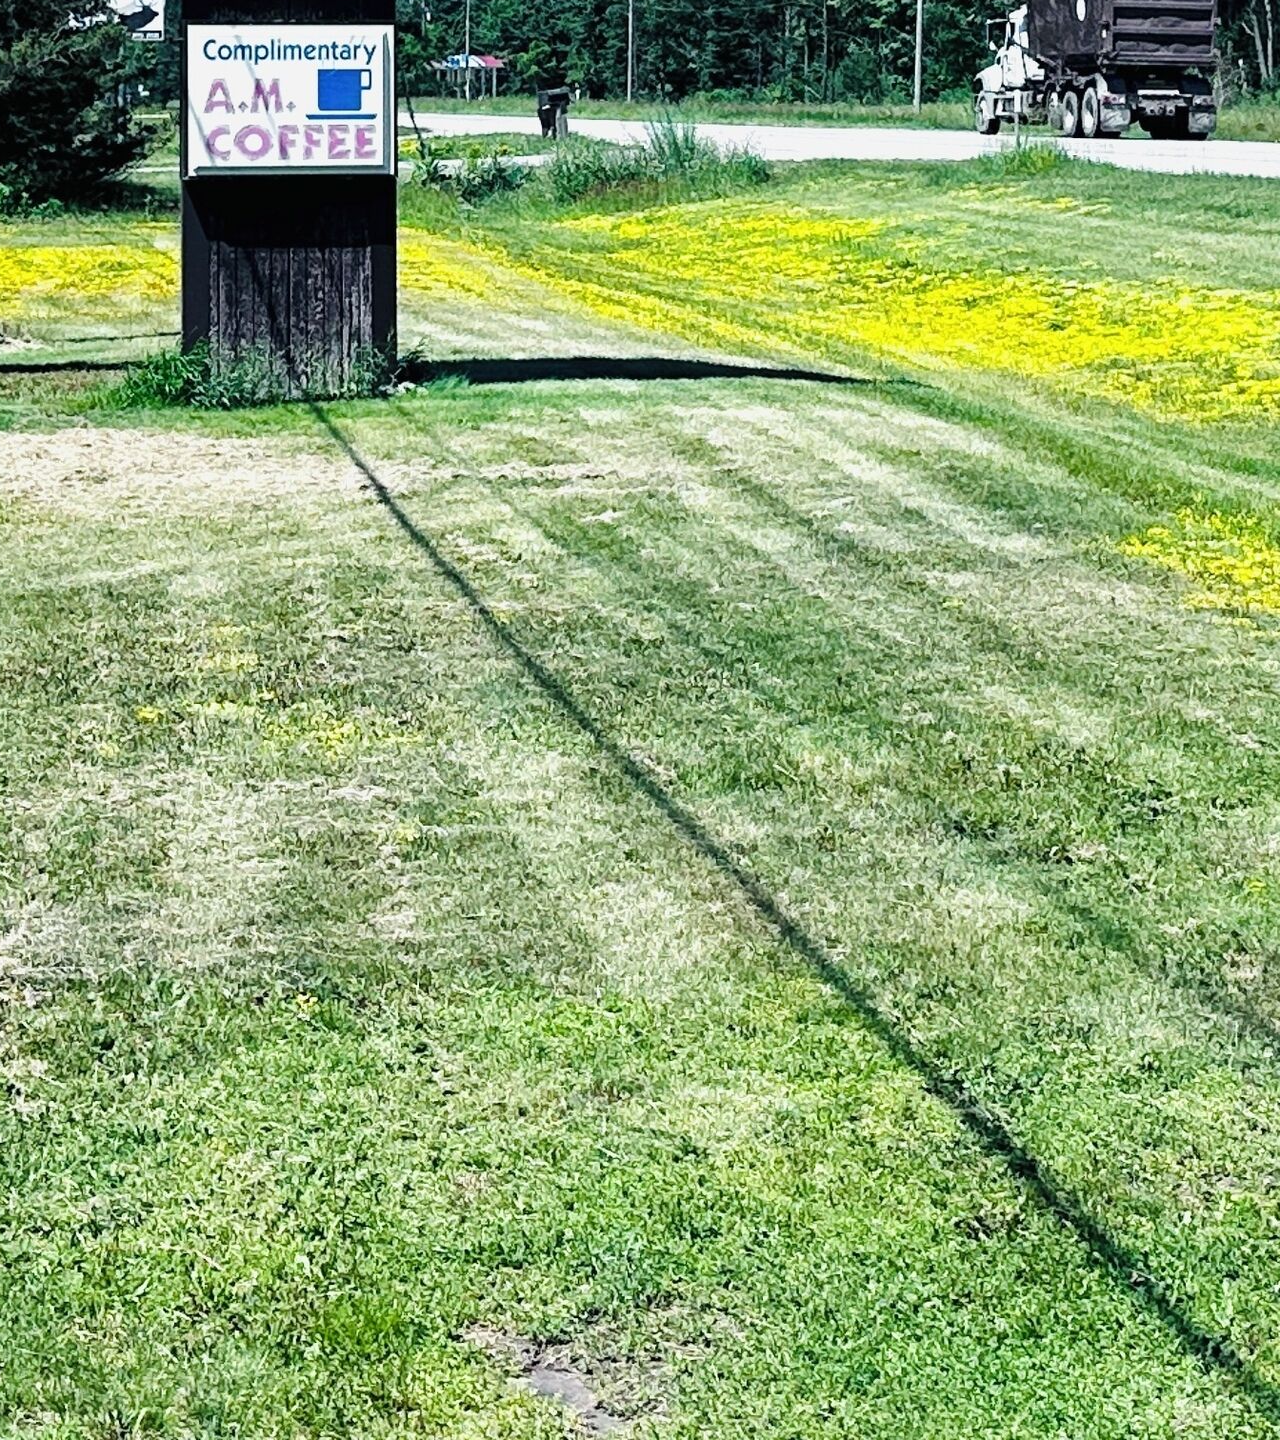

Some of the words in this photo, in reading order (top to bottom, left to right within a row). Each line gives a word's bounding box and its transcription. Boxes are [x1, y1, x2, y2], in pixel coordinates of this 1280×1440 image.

[203, 39, 377, 65] Complimentary
[203, 78, 297, 115] A.M.
[206, 124, 377, 161] COFFEE
